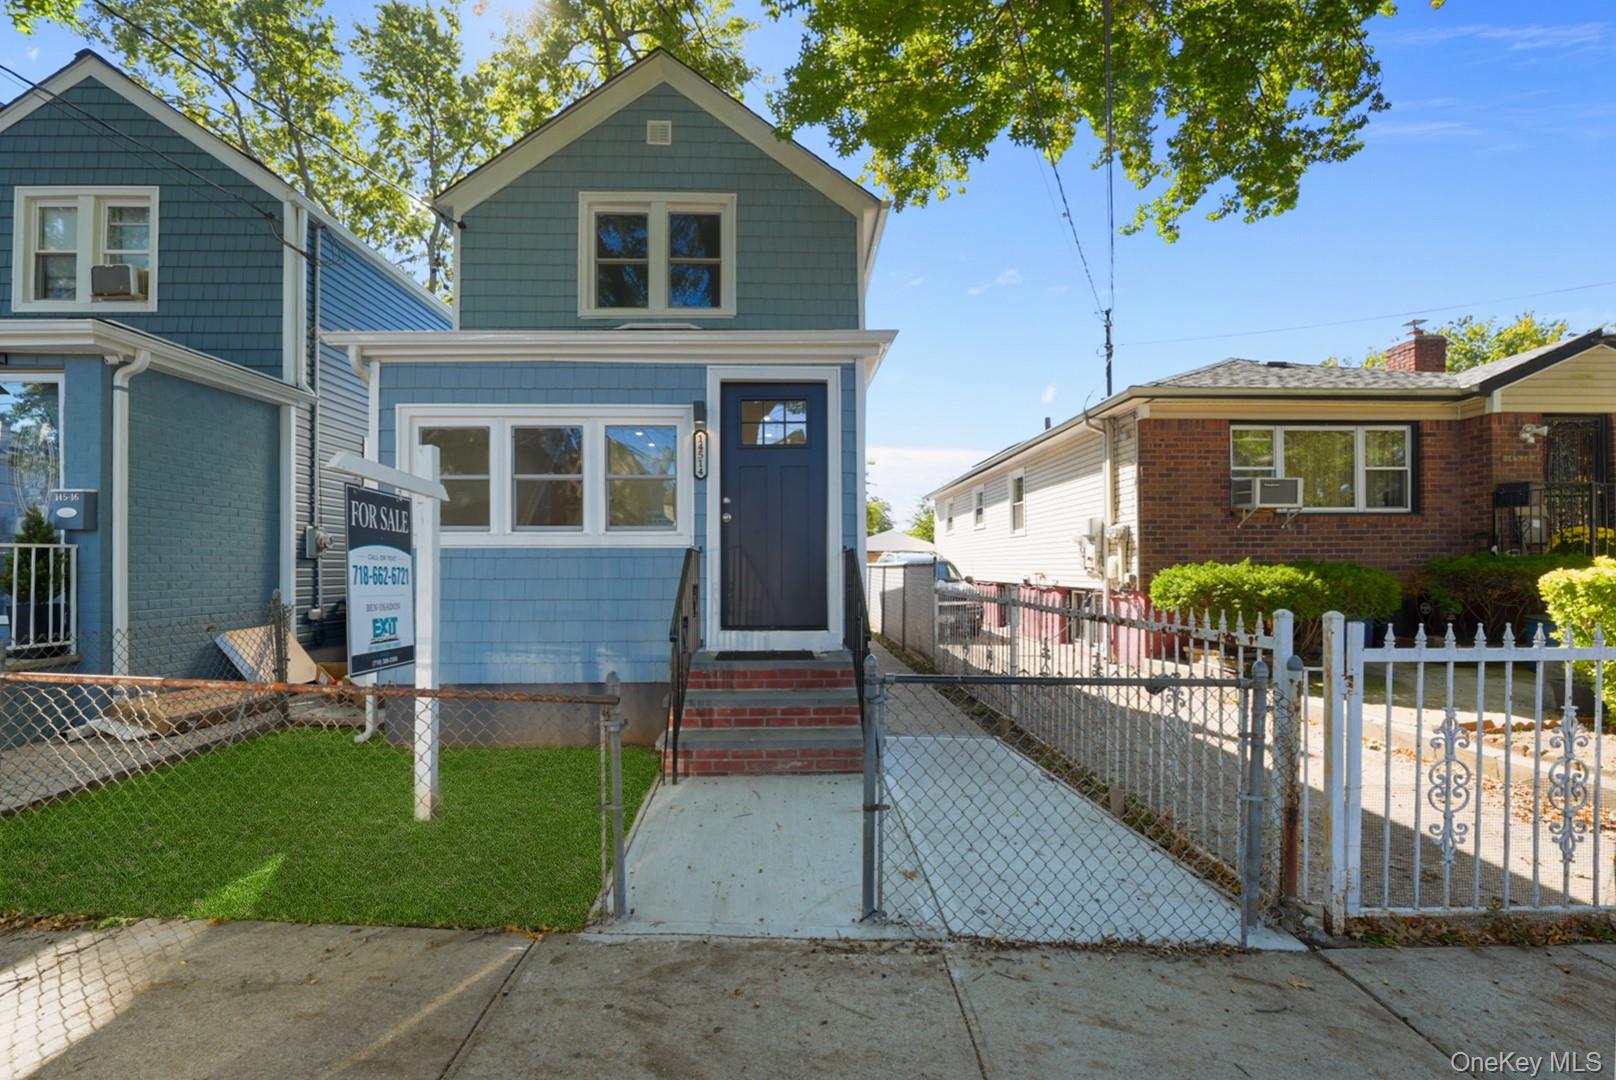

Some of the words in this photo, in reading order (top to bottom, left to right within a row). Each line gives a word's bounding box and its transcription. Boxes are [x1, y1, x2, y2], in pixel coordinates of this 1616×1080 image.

[697, 434, 705, 476] 14514
[351, 500, 378, 529] FOR
[380, 506, 409, 533] SALE
[352, 565, 409, 585] 718-662-6721
[372, 616, 398, 638] EXIT
